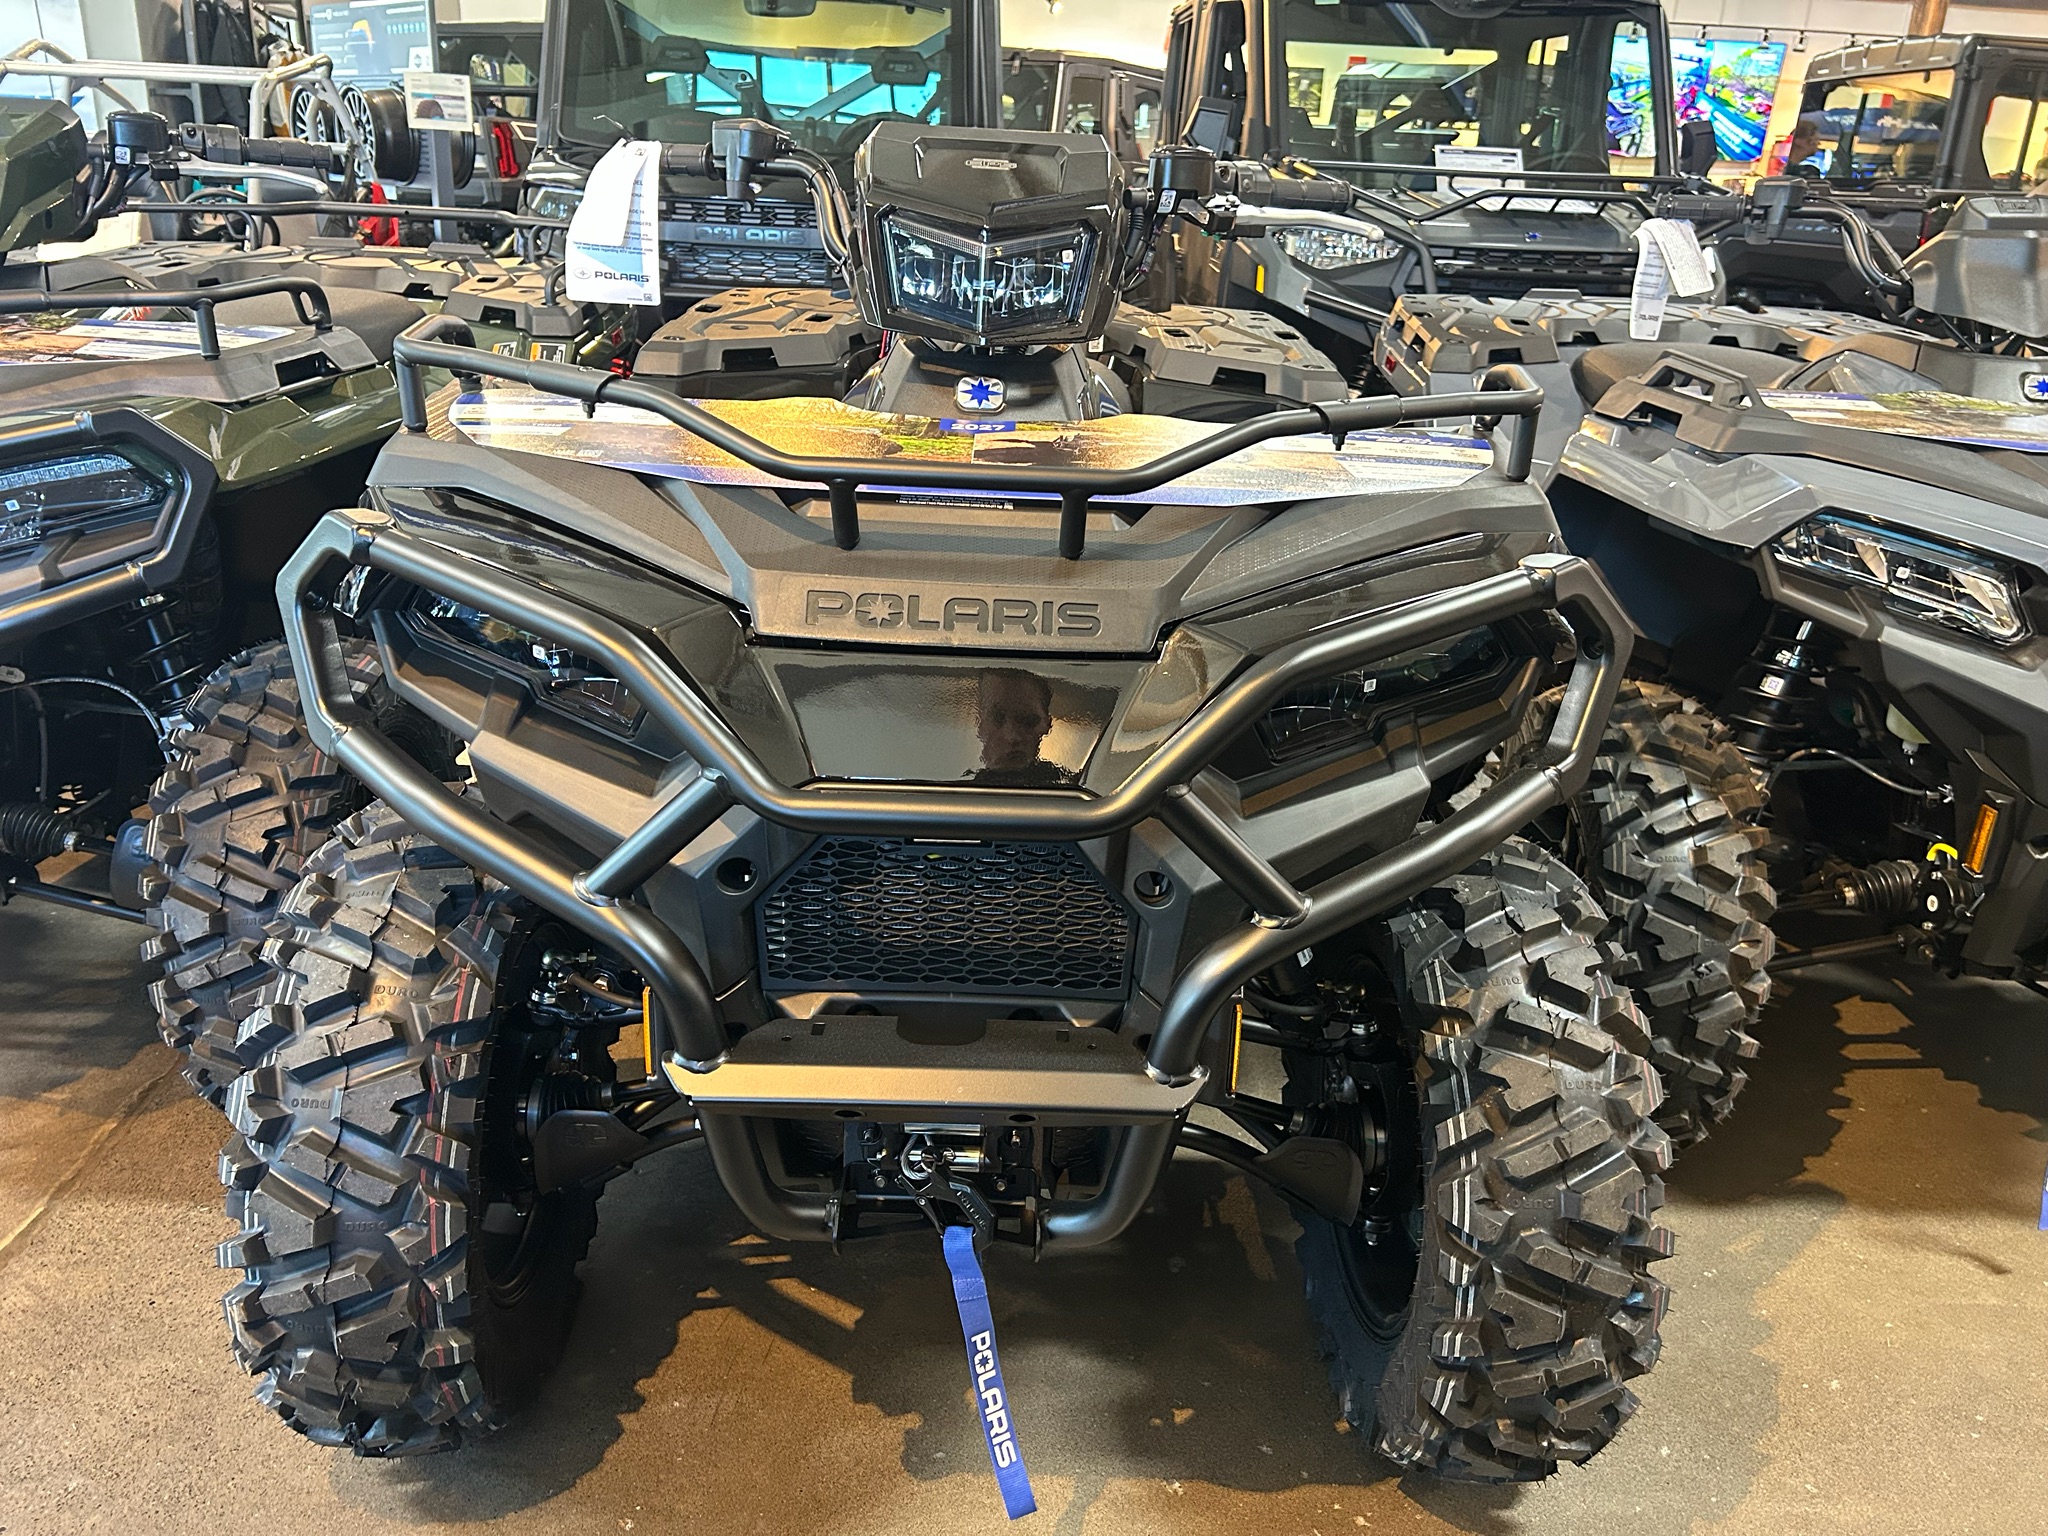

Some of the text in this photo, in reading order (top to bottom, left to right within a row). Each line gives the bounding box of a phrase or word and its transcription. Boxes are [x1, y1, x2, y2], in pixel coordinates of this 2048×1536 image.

[694, 225, 807, 245] POLARIS
[594, 271, 650, 283] POLARIS
[950, 423, 1006, 431] 2027
[805, 589, 1102, 638] POLARIS
[373, 984, 419, 999] DURO
[290, 1097, 331, 1110] DURO
[344, 1219, 388, 1233] DURO
[970, 1330, 1018, 1469] POLARIS
